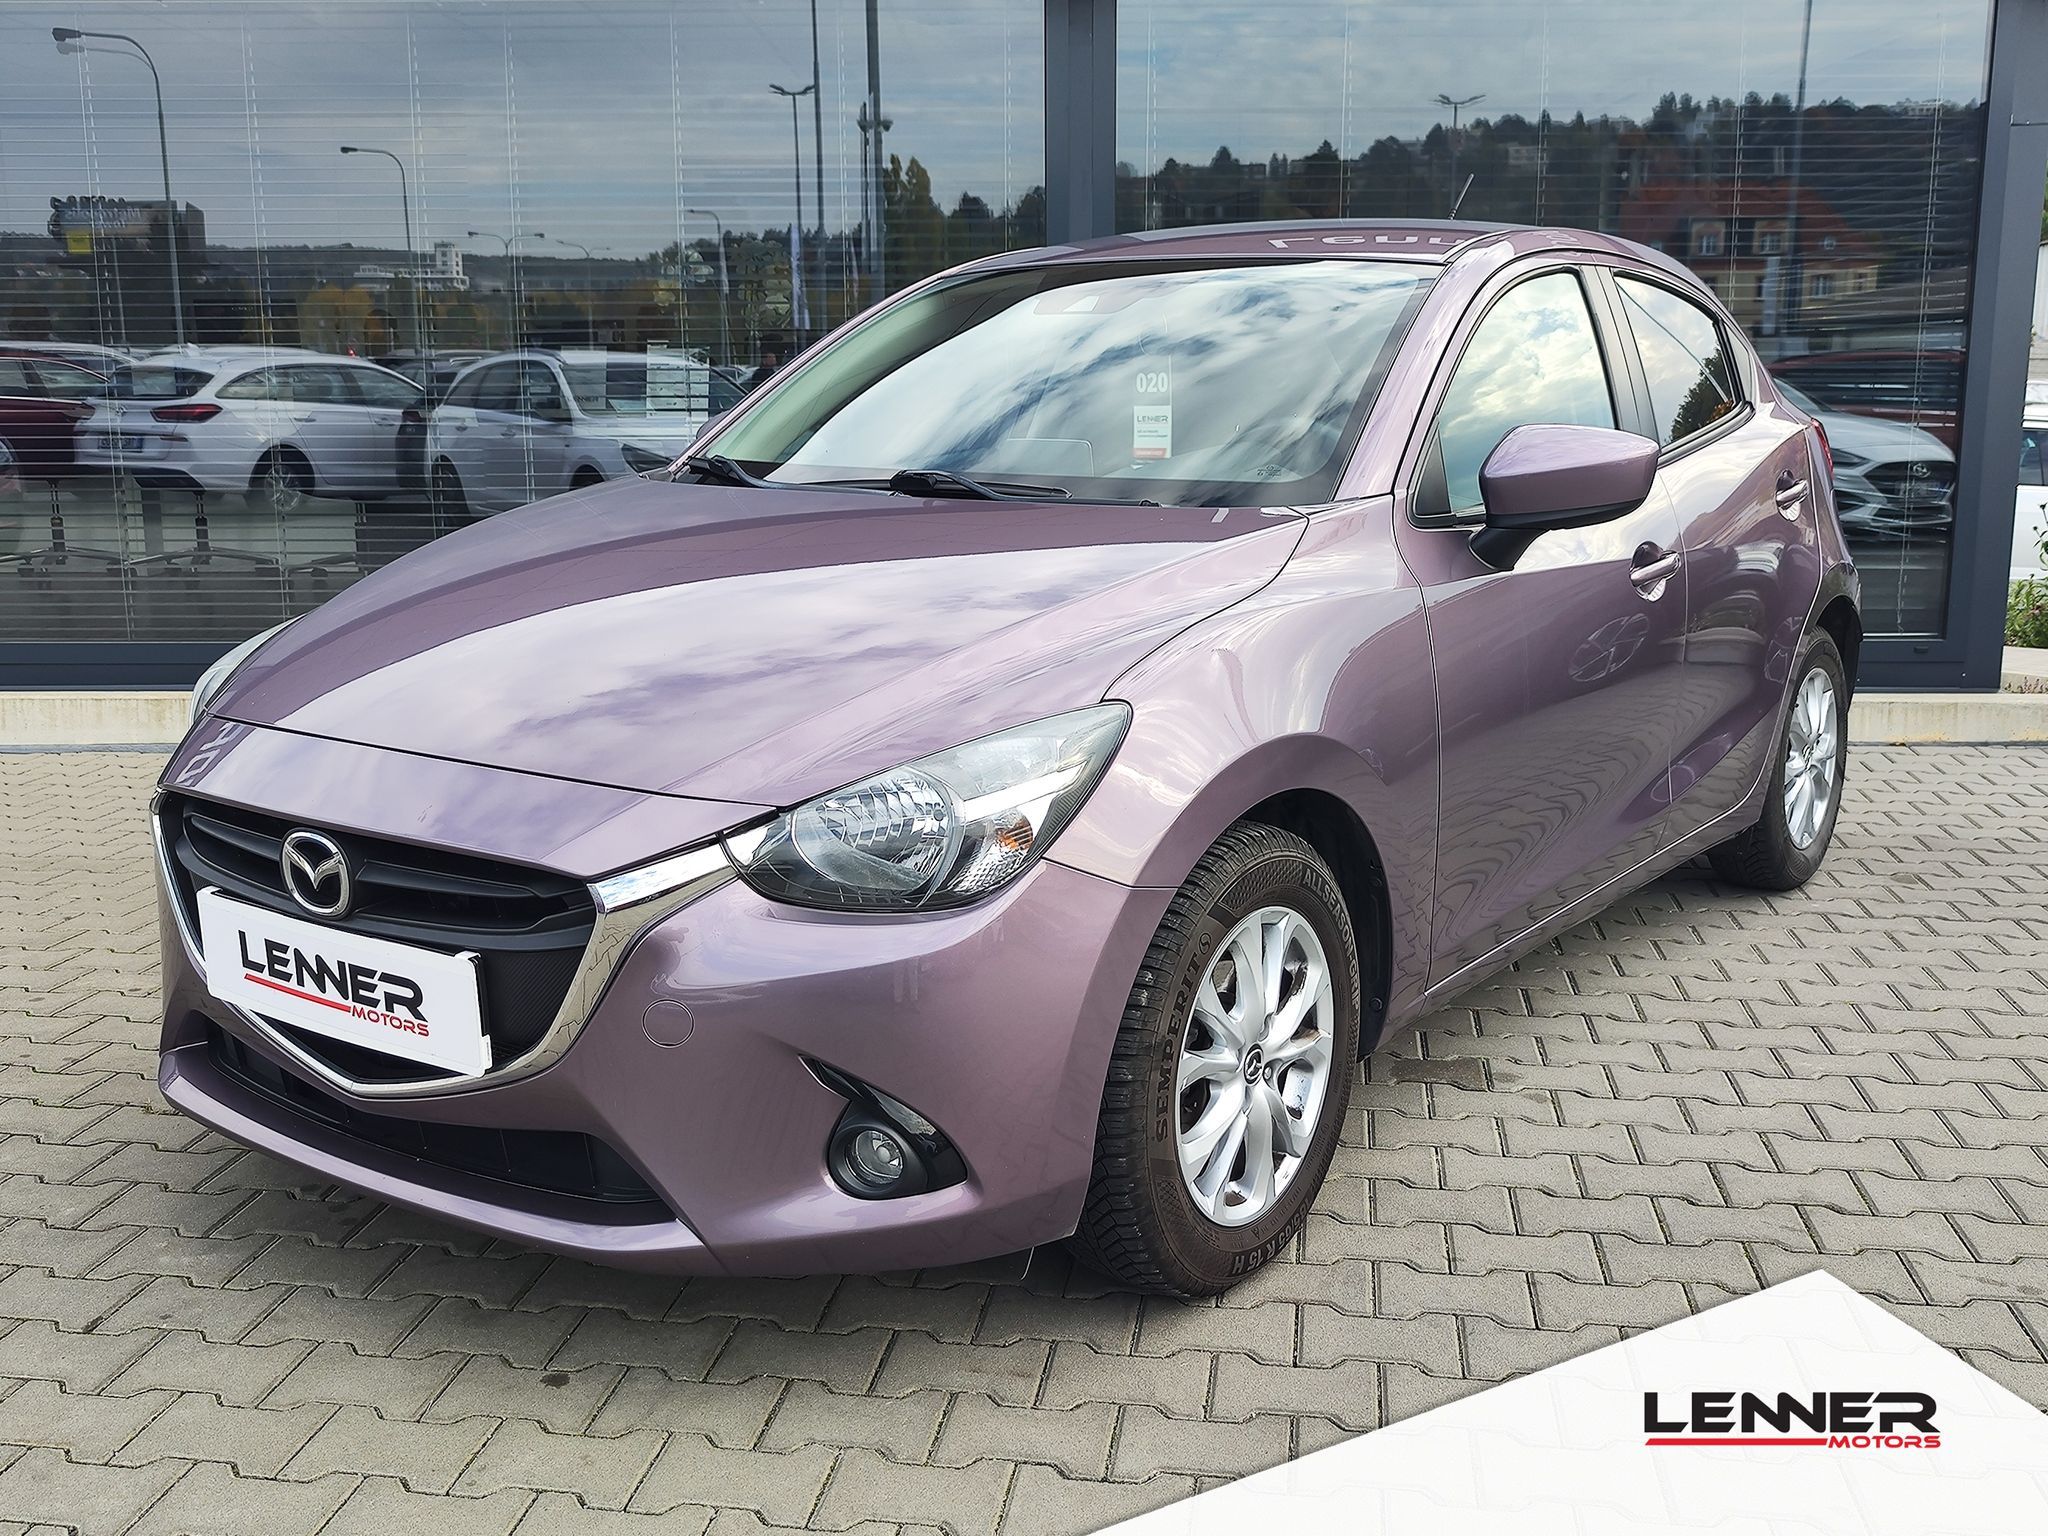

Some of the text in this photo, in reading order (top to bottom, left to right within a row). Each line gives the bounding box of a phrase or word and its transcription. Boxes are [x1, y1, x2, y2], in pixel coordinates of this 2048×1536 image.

[1136, 372, 1168, 393] 020
[238, 930, 428, 1023] LENNER
[352, 1005, 430, 1036] MOTORS
[1156, 952, 1202, 1142] SEMPERIT
